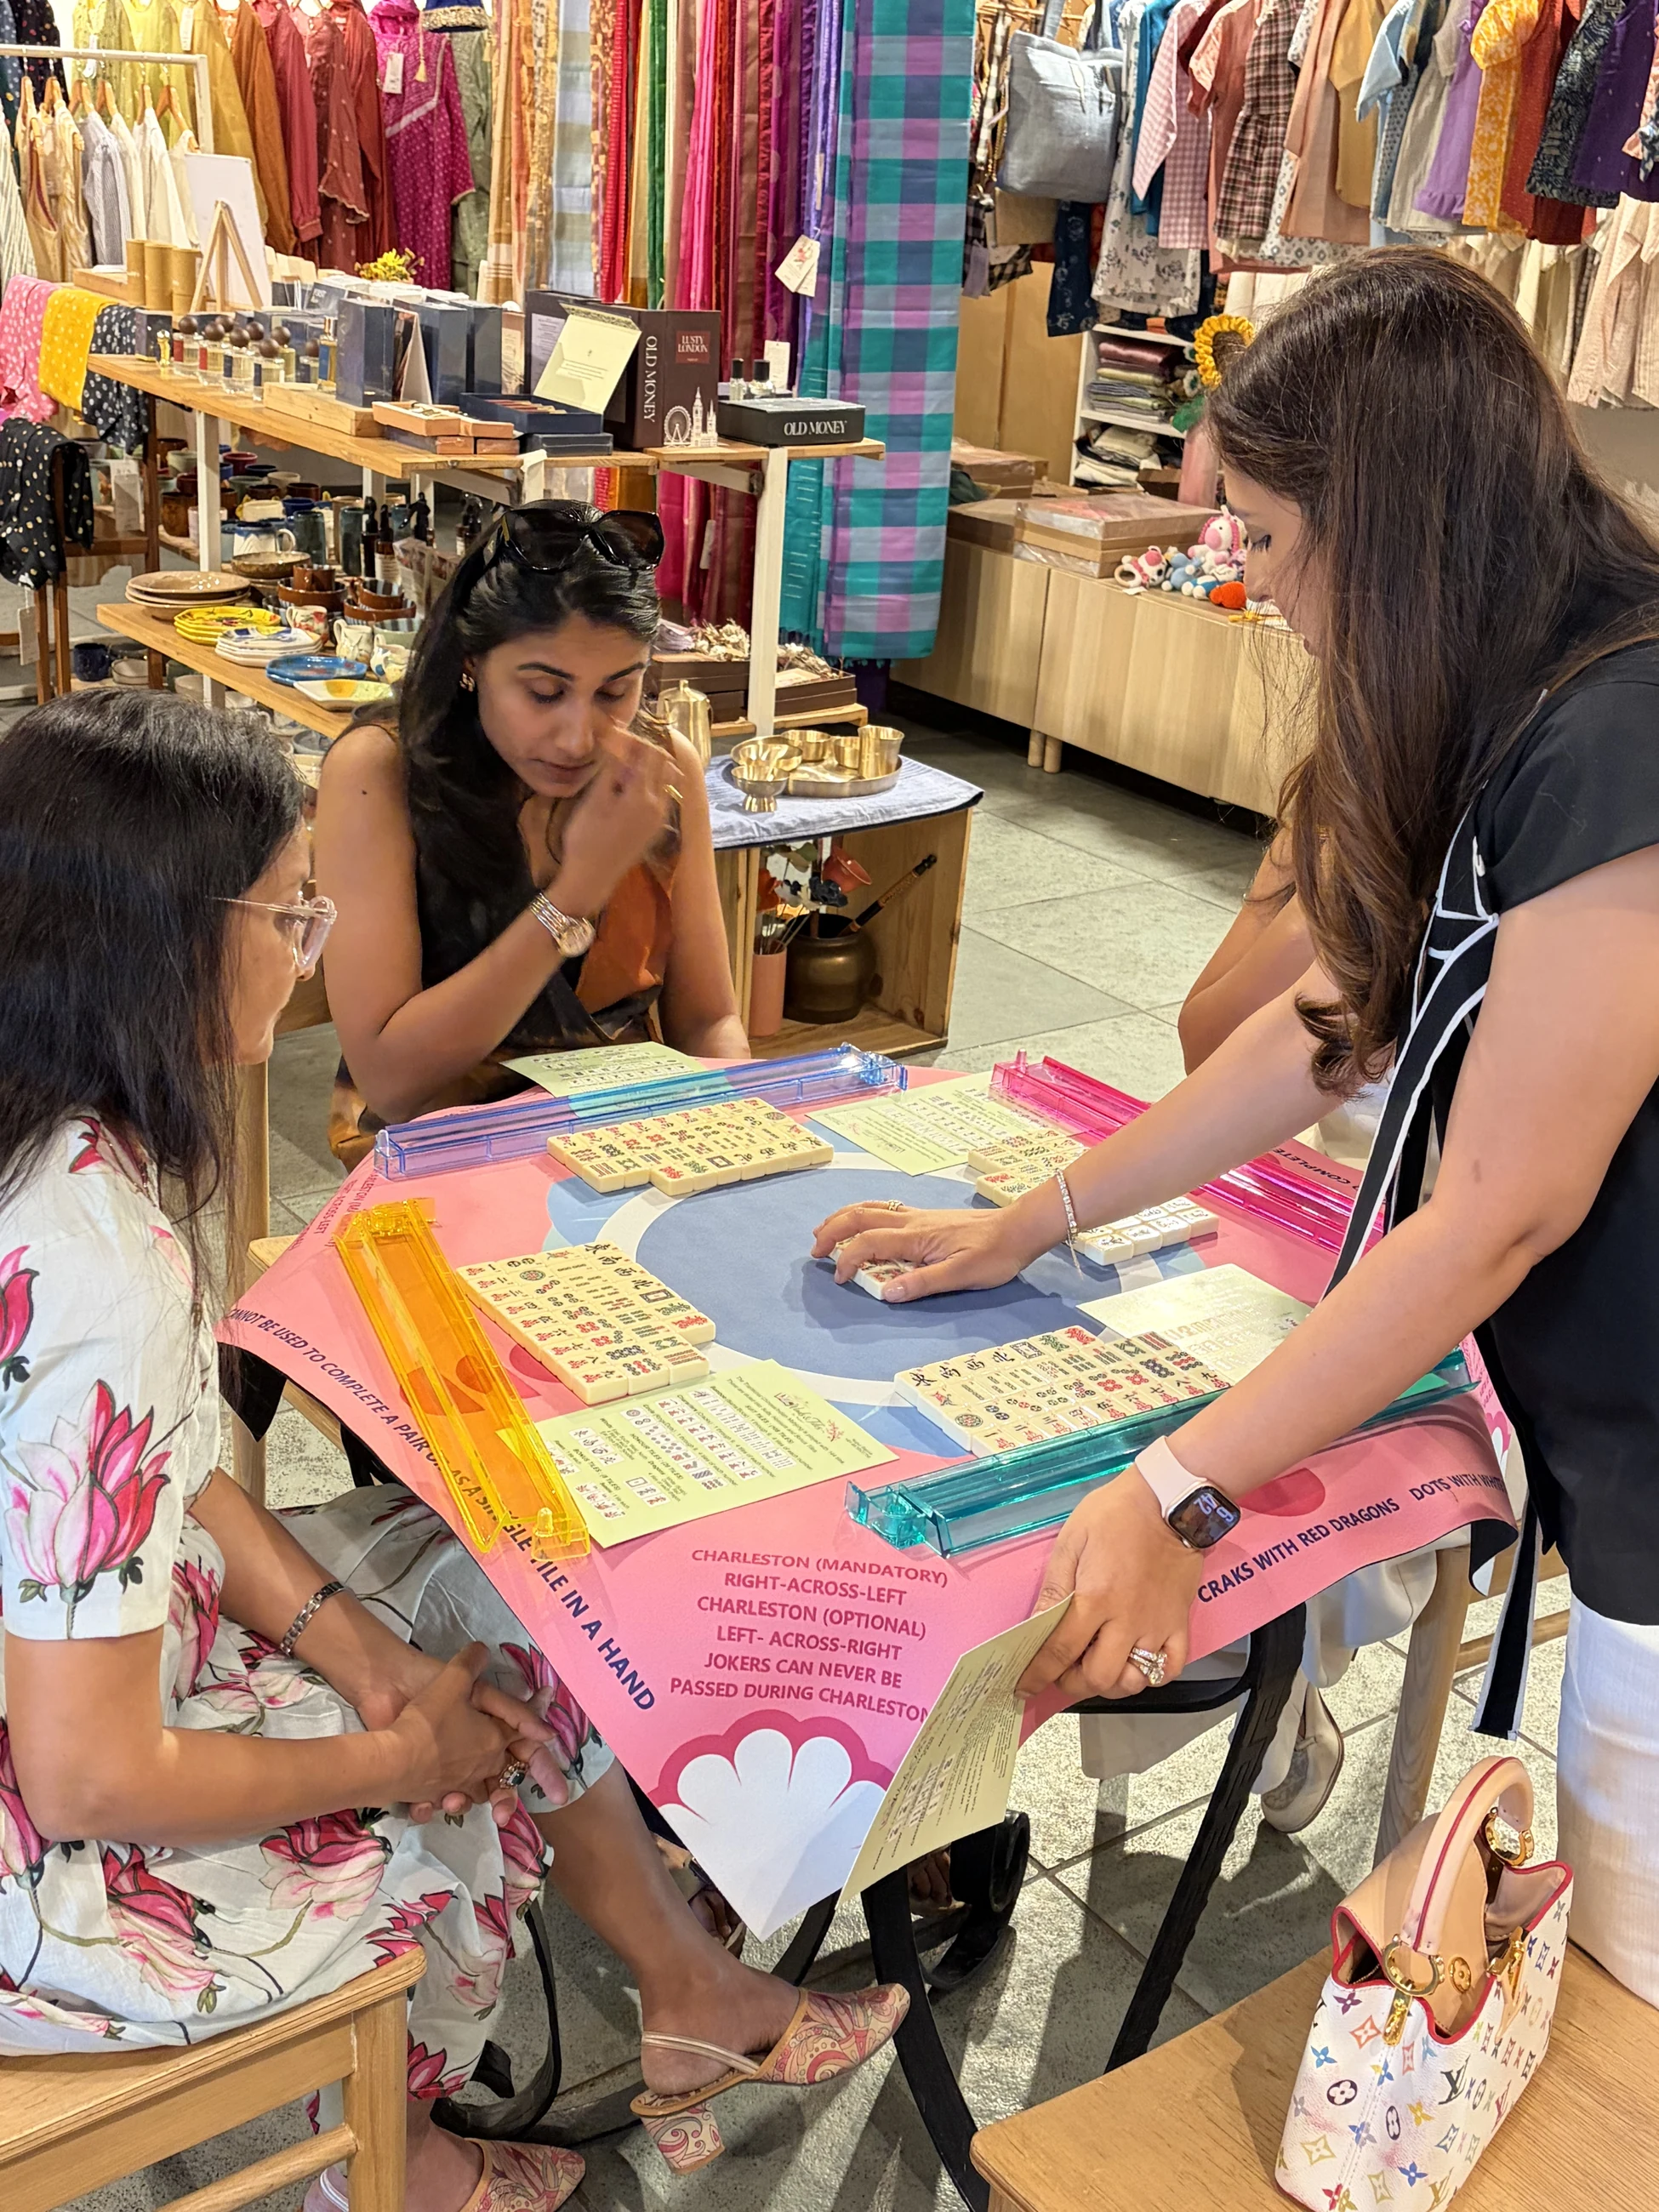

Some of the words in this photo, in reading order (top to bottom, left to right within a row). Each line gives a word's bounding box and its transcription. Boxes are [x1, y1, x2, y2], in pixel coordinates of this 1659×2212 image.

[646, 336, 658, 367] OLD
[678, 344, 708, 352] LONDON
[682, 335, 704, 344] LUSTY
[644, 370, 657, 422] MONEY
[784, 421, 807, 436] OLD
[808, 420, 846, 436] MONEY
[1273, 1148, 1351, 1185] COMPLETE
[1193, 1492, 1218, 1515] 42
[1409, 1478, 1451, 1501] DOTS
[1447, 1474, 1482, 1487] WITH
[258, 1319, 280, 1331] BE
[272, 1327, 309, 1348] USED
[303, 1348, 326, 1362] TO
[320, 1362, 390, 1414] COMPLETE
[380, 1415, 399, 1425] A
[393, 1424, 430, 1452] PAIR
[462, 1486, 482, 1497] A
[561, 1589, 590, 1618] IN
[580, 1620, 602, 1640] A
[597, 1637, 655, 1710] HAND
[1216, 1506, 1234, 1523] 6
[1197, 1561, 1255, 1604] CRAKS
[1251, 1539, 1301, 1571] WITH
[1296, 1525, 1331, 1548] RED
[1328, 1497, 1400, 1532] DRAGONS
[692, 1549, 810, 1570] CHARLESTON
[815, 1557, 948, 1588] (MANDATORY)
[724, 1572, 907, 1606] RIGHT-ACROSS-LEFT
[697, 1596, 818, 1622] CHARLESTON
[823, 1607, 926, 1640] (OPTIONAL)
[716, 1625, 764, 1643] LEFT-
[769, 1630, 903, 1661] ACROSS-RIGHT
[704, 1652, 771, 1673] JOKERS
[776, 1658, 813, 1678] CAN
[818, 1662, 875, 1684] NEVER
[881, 1670, 903, 1689] BE
[670, 1677, 738, 1698] PASSED
[744, 1683, 813, 1701] DURING
